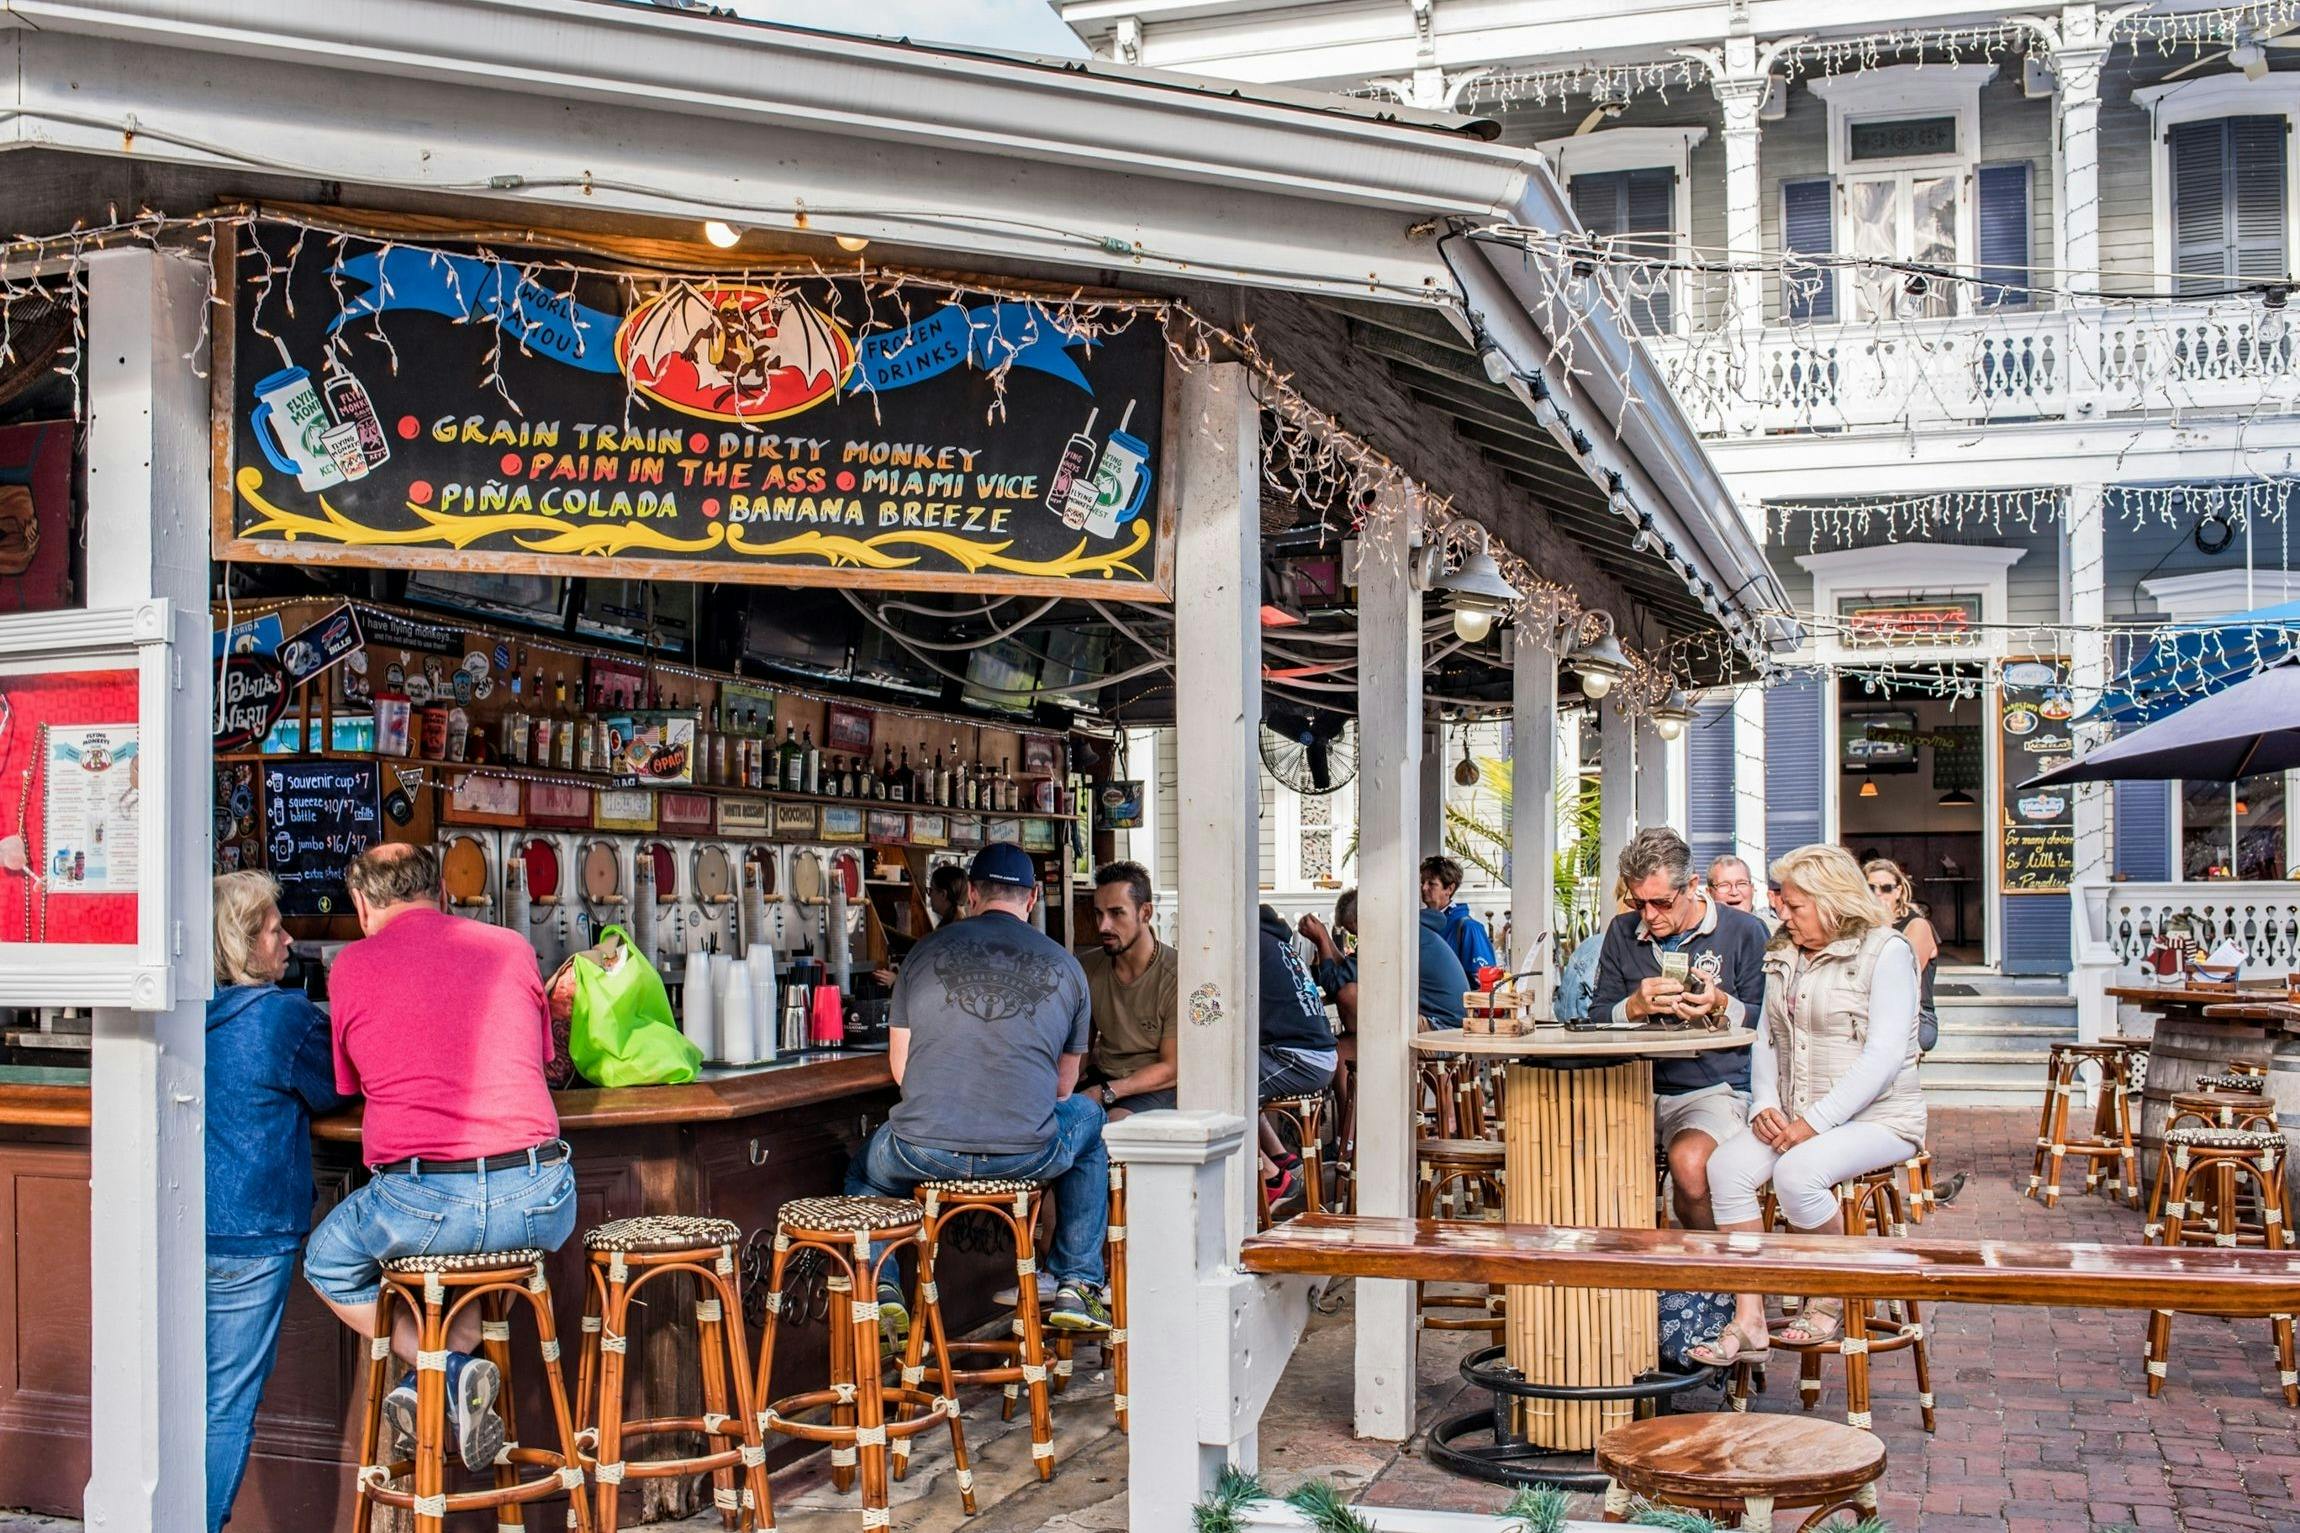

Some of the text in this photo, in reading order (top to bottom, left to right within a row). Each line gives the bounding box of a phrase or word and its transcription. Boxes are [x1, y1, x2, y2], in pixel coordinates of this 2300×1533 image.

[521, 284, 580, 321] WORLD
[866, 319, 942, 359] FROZEN
[877, 340, 959, 385] DRINKS
[432, 415, 982, 473] GRAIN TRAIN DIRTY MONKEY
[529, 453, 1039, 500] PAIN IN THE ASS MIAMI VICE
[441, 479, 1012, 533] PIÑA COLADA BANANA BREEZE
[229, 621, 260, 638] ORIDA
[367, 617, 388, 631] have
[390, 621, 413, 637] flying
[329, 635, 353, 656] BILLS
[287, 772, 370, 795] souvenir cup $7
[288, 797, 325, 815] squeeze
[354, 806, 375, 821] refills
[290, 810, 318, 823] bottle
[298, 835, 325, 854] jumbo
[2005, 828, 2018, 846] So
[2022, 836, 2046, 853] many
[2006, 852, 2020, 869] So
[2025, 852, 2056, 869] little
